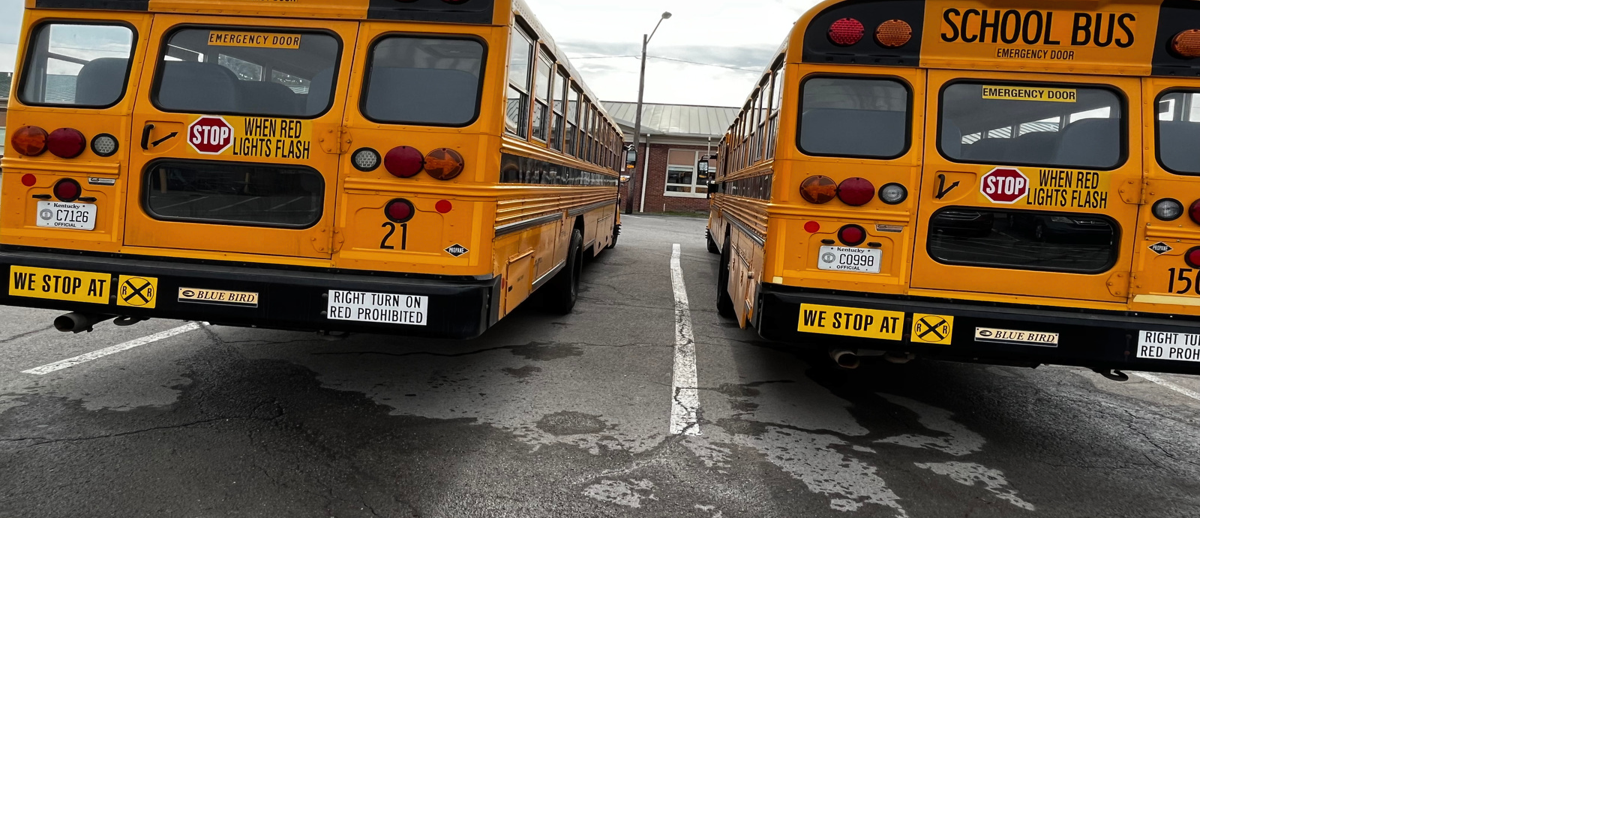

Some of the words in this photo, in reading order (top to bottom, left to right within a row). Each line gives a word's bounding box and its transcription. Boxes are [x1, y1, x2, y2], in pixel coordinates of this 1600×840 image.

[940, 8, 1061, 45] SCHOOL
[1071, 12, 1136, 48] BUS
[209, 33, 269, 44] EMERGENCY
[272, 35, 300, 46] DOOR
[996, 48, 1048, 60] EMERGENCY
[1050, 49, 1075, 60] DOOR
[982, 87, 1045, 99] EMERGENCY
[1047, 90, 1076, 101] DOOR
[192, 125, 230, 146] STOP
[244, 117, 278, 137] WHEN
[280, 119, 302, 139] RED
[232, 137, 273, 158] LIGHTS
[275, 139, 311, 160] FLASH
[985, 176, 1025, 196] STOP
[1039, 169, 1074, 188] WHEN
[1075, 171, 1100, 191] RED
[53, 202, 80, 210] Kentucky
[1026, 188, 1068, 207] LIGHTS
[1070, 191, 1108, 209] FLASH
[56, 209, 89, 223] C7126
[380, 222, 408, 250] 21
[13, 271, 37, 291] WE
[42, 274, 82, 295] STOP
[87, 278, 107, 298] AT
[121, 286, 128, 296] R
[146, 288, 153, 298] R
[196, 290, 226, 301] BLUE
[228, 292, 256, 303] BIRD
[334, 291, 366, 305] RIGHT
[371, 293, 400, 307] TURN
[405, 295, 422, 309] ON
[329, 306, 352, 319] RED
[357, 308, 423, 323] PROHIBITED
[803, 309, 828, 328] WE
[832, 311, 874, 332] STOP
[879, 316, 900, 334] AT
[916, 323, 922, 333] R
[942, 325, 948, 335] R
[994, 330, 1025, 341] BLUE
[1027, 332, 1056, 343] BIRD
[1144, 331, 1179, 345] RIGHT
[1184, 334, 1200, 347] TU
[1140, 345, 1163, 358] RED
